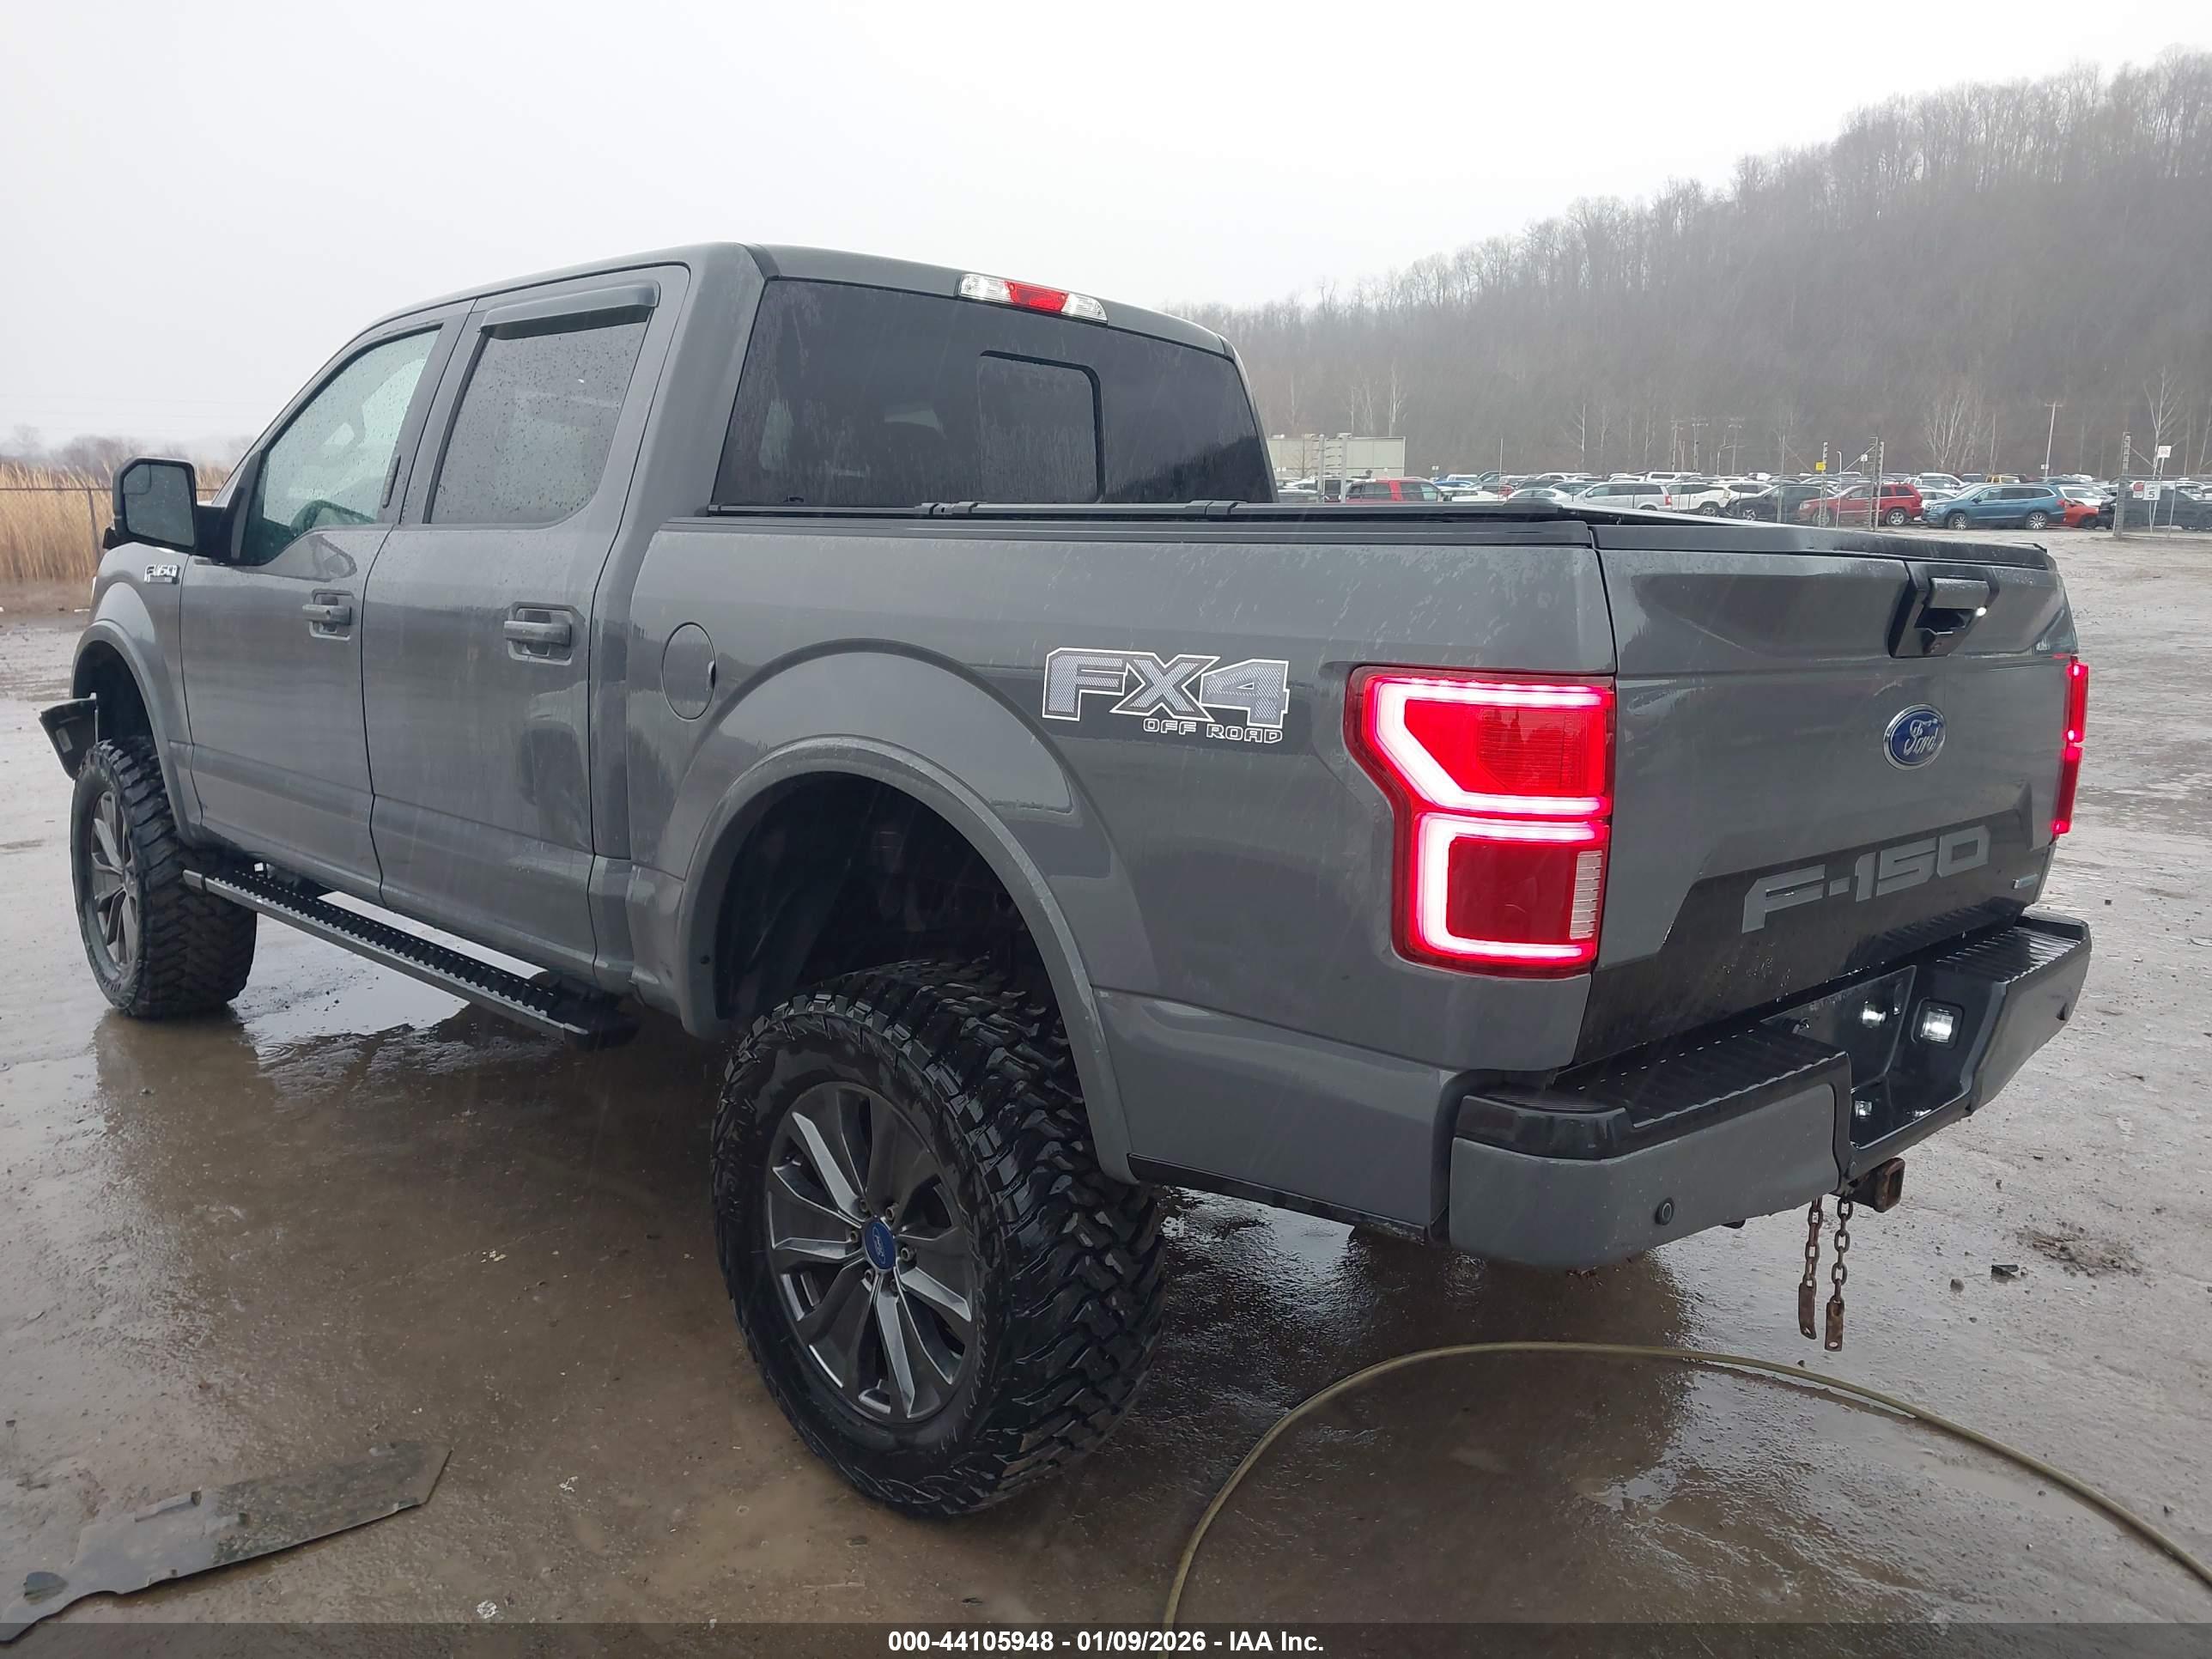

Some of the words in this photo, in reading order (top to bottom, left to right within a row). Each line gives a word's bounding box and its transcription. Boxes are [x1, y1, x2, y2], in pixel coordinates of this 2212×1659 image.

[2148, 490, 2155, 499] 5
[1042, 647, 1290, 728] FX4
[1143, 718, 1196, 734] OFF
[1206, 722, 1284, 744] ROAD
[1903, 718, 1939, 757] Ford
[1741, 824, 1990, 934] F-150
